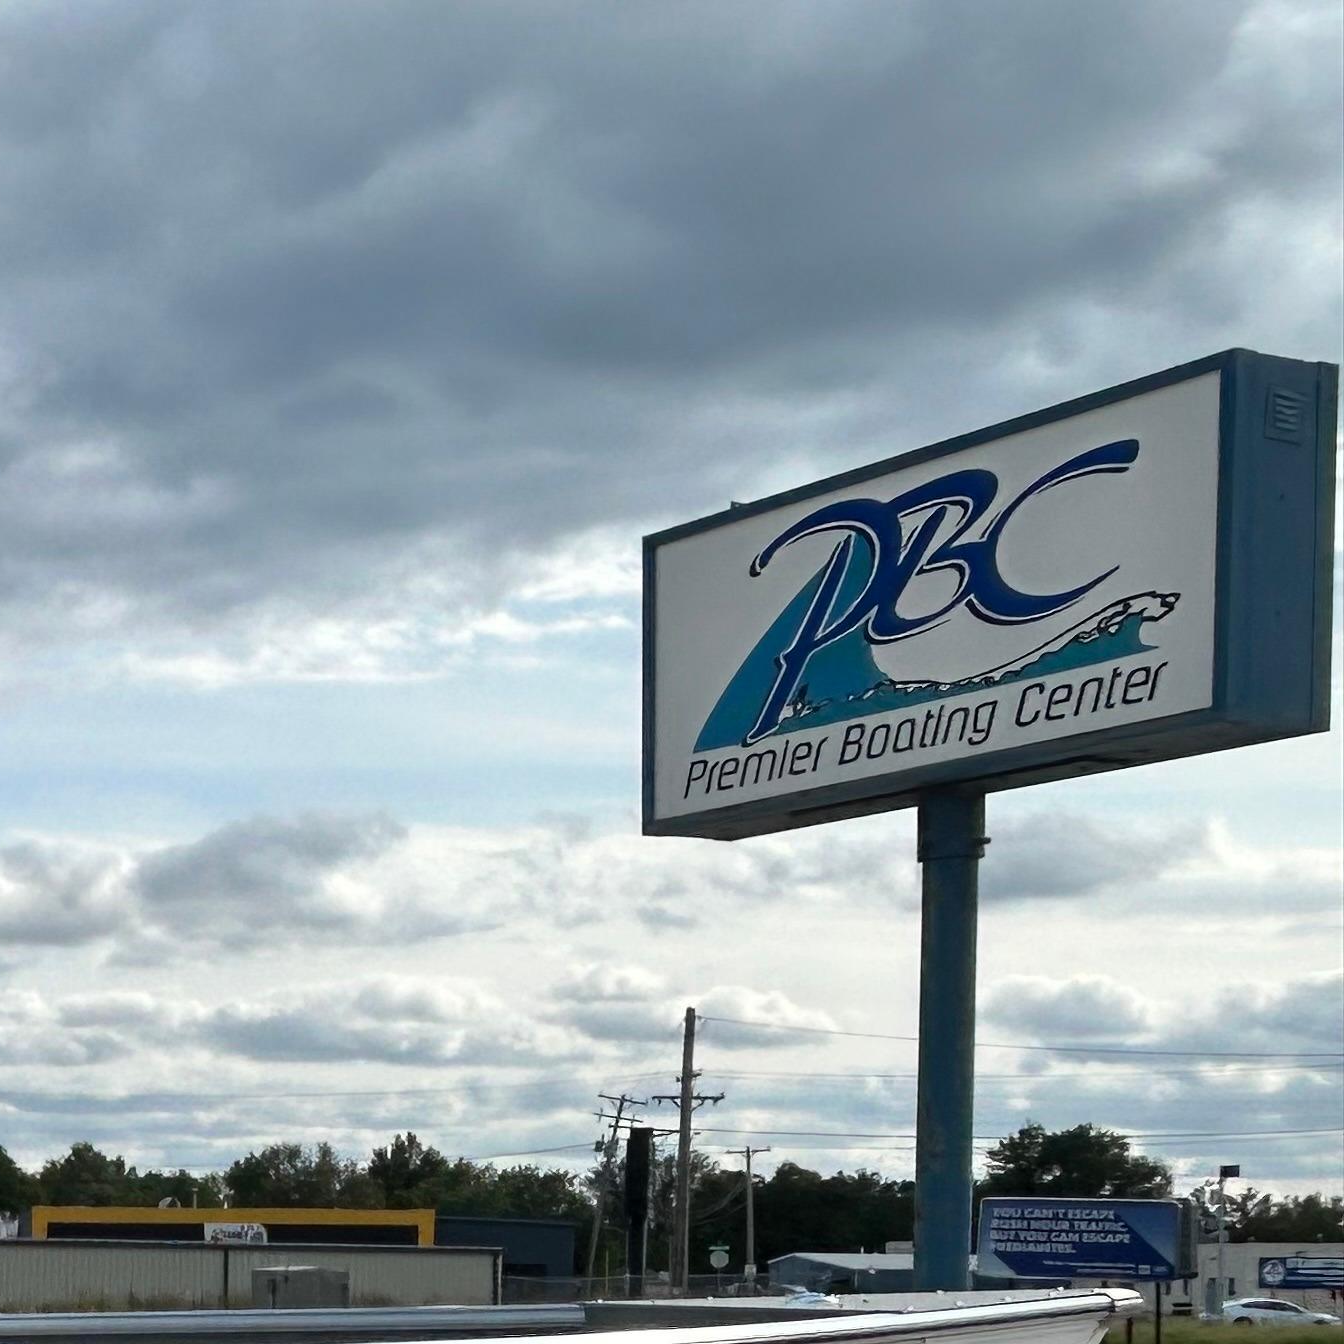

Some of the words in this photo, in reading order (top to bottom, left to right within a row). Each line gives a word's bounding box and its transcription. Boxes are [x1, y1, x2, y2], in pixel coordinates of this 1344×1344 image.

[742, 438, 1140, 747] PBC
[683, 735, 829, 799] Premier
[838, 699, 997, 766] Boating
[1016, 661, 1169, 728] Center
